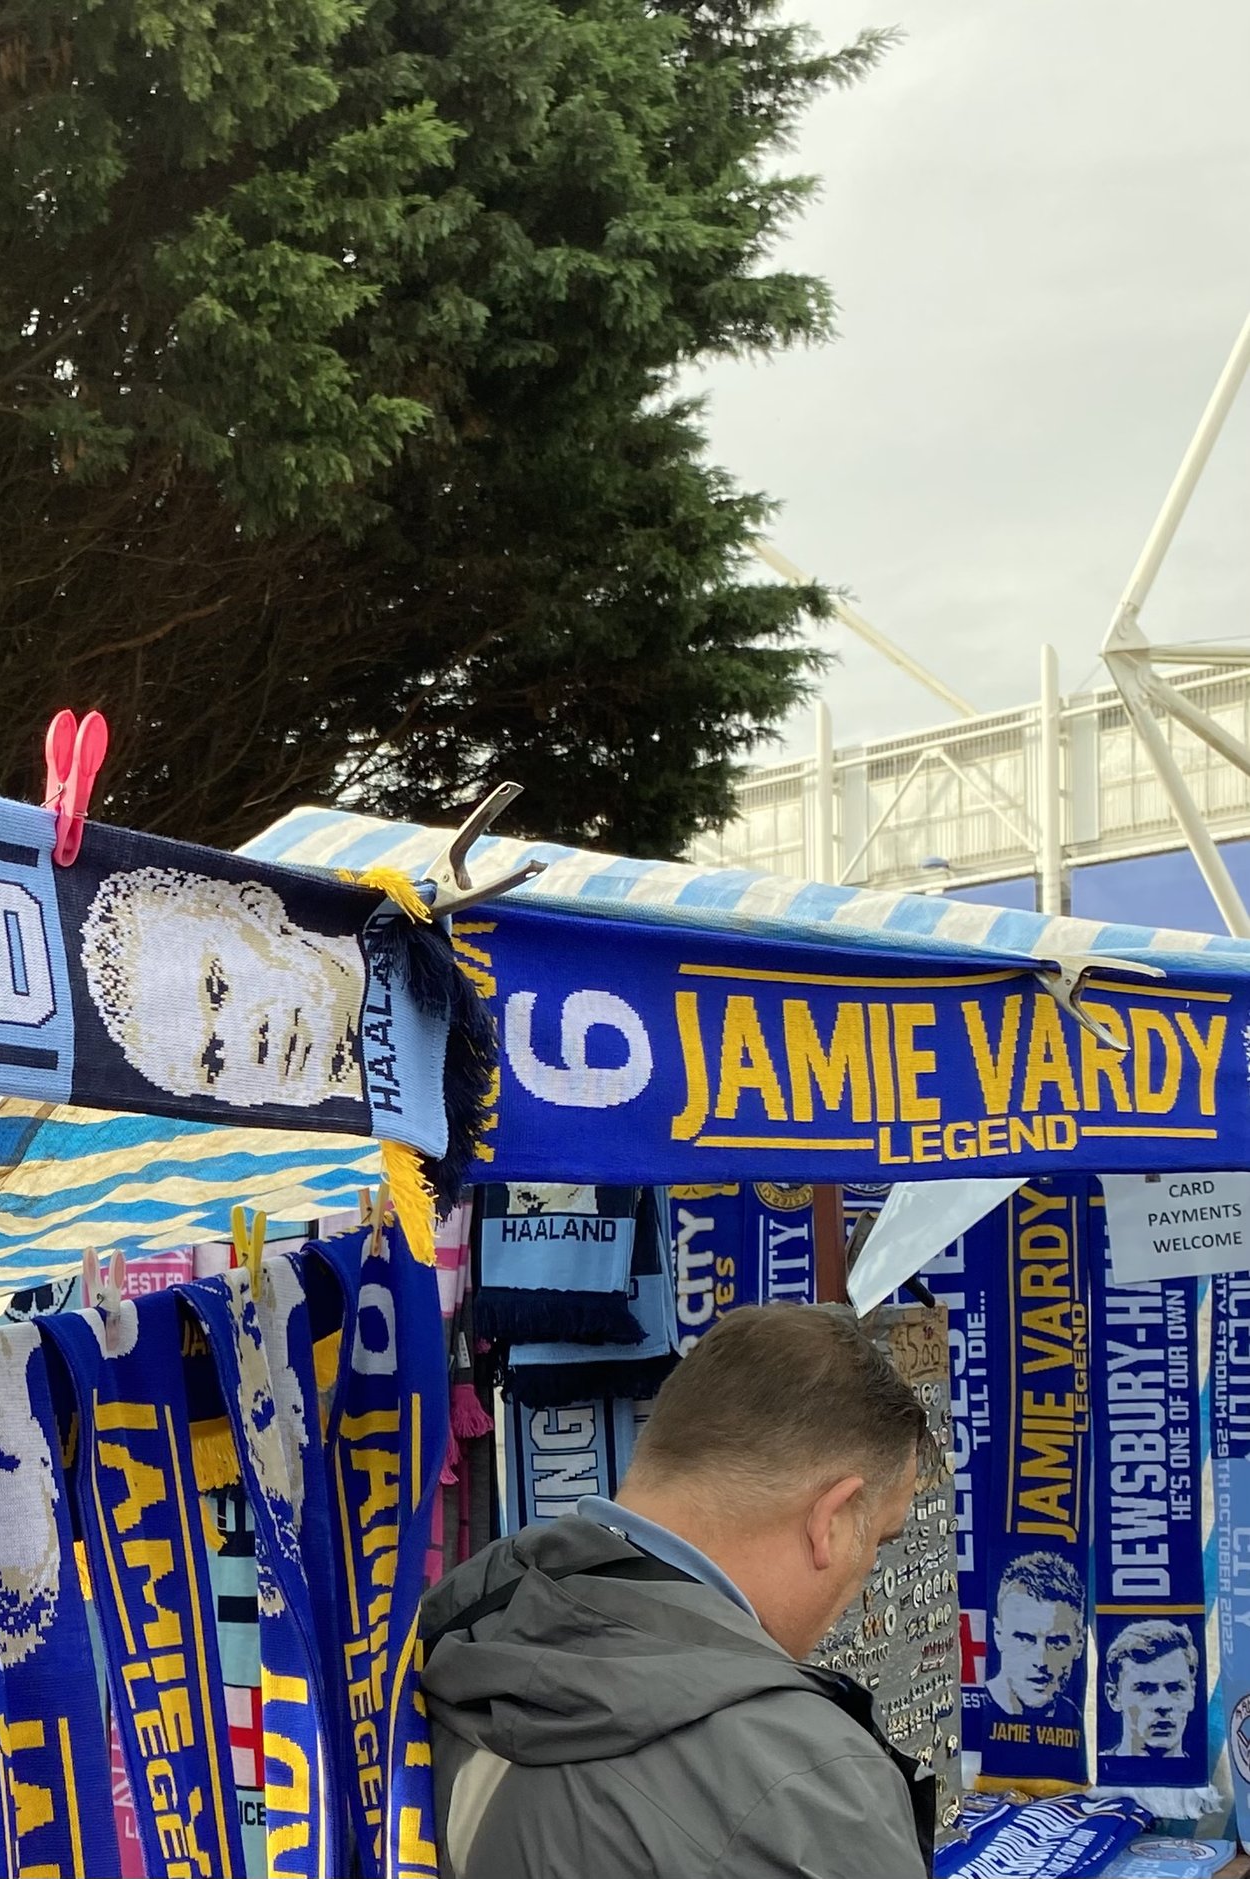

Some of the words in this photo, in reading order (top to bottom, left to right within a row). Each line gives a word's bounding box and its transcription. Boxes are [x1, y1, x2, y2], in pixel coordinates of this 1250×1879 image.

[671, 989, 942, 1142] JAMIE
[961, 992, 1228, 1118] VARDY
[877, 1112, 1079, 1165] LEGEND
[1147, 1203, 1243, 1227] PAYMENTS
[1168, 1180, 1216, 1198] CARD
[501, 1218, 617, 1243] HAALAND
[1152, 1231, 1243, 1254] WELCOME
[676, 1207, 715, 1327] CITY
[767, 1218, 810, 1305] ITY
[1018, 1184, 1075, 1375] VARDY
[1165, 1289, 1188, 1340] OWN
[1071, 1302, 1090, 1433] LEGEND
[1167, 1345, 1189, 1389] OUR
[969, 1384, 992, 1451] TILL
[1168, 1394, 1190, 1421] OF
[529, 1405, 600, 1519] ING
[1016, 1389, 1078, 1544] JAMIE
[1168, 1426, 1191, 1469] ONE
[1169, 1474, 1192, 1521] HE'S
[1218, 1492, 1232, 1593] OCTOBER
[1219, 1596, 1235, 1656] 2022
[989, 1721, 1031, 1744] JAMIE
[1036, 1725, 1081, 1749] VARDY
